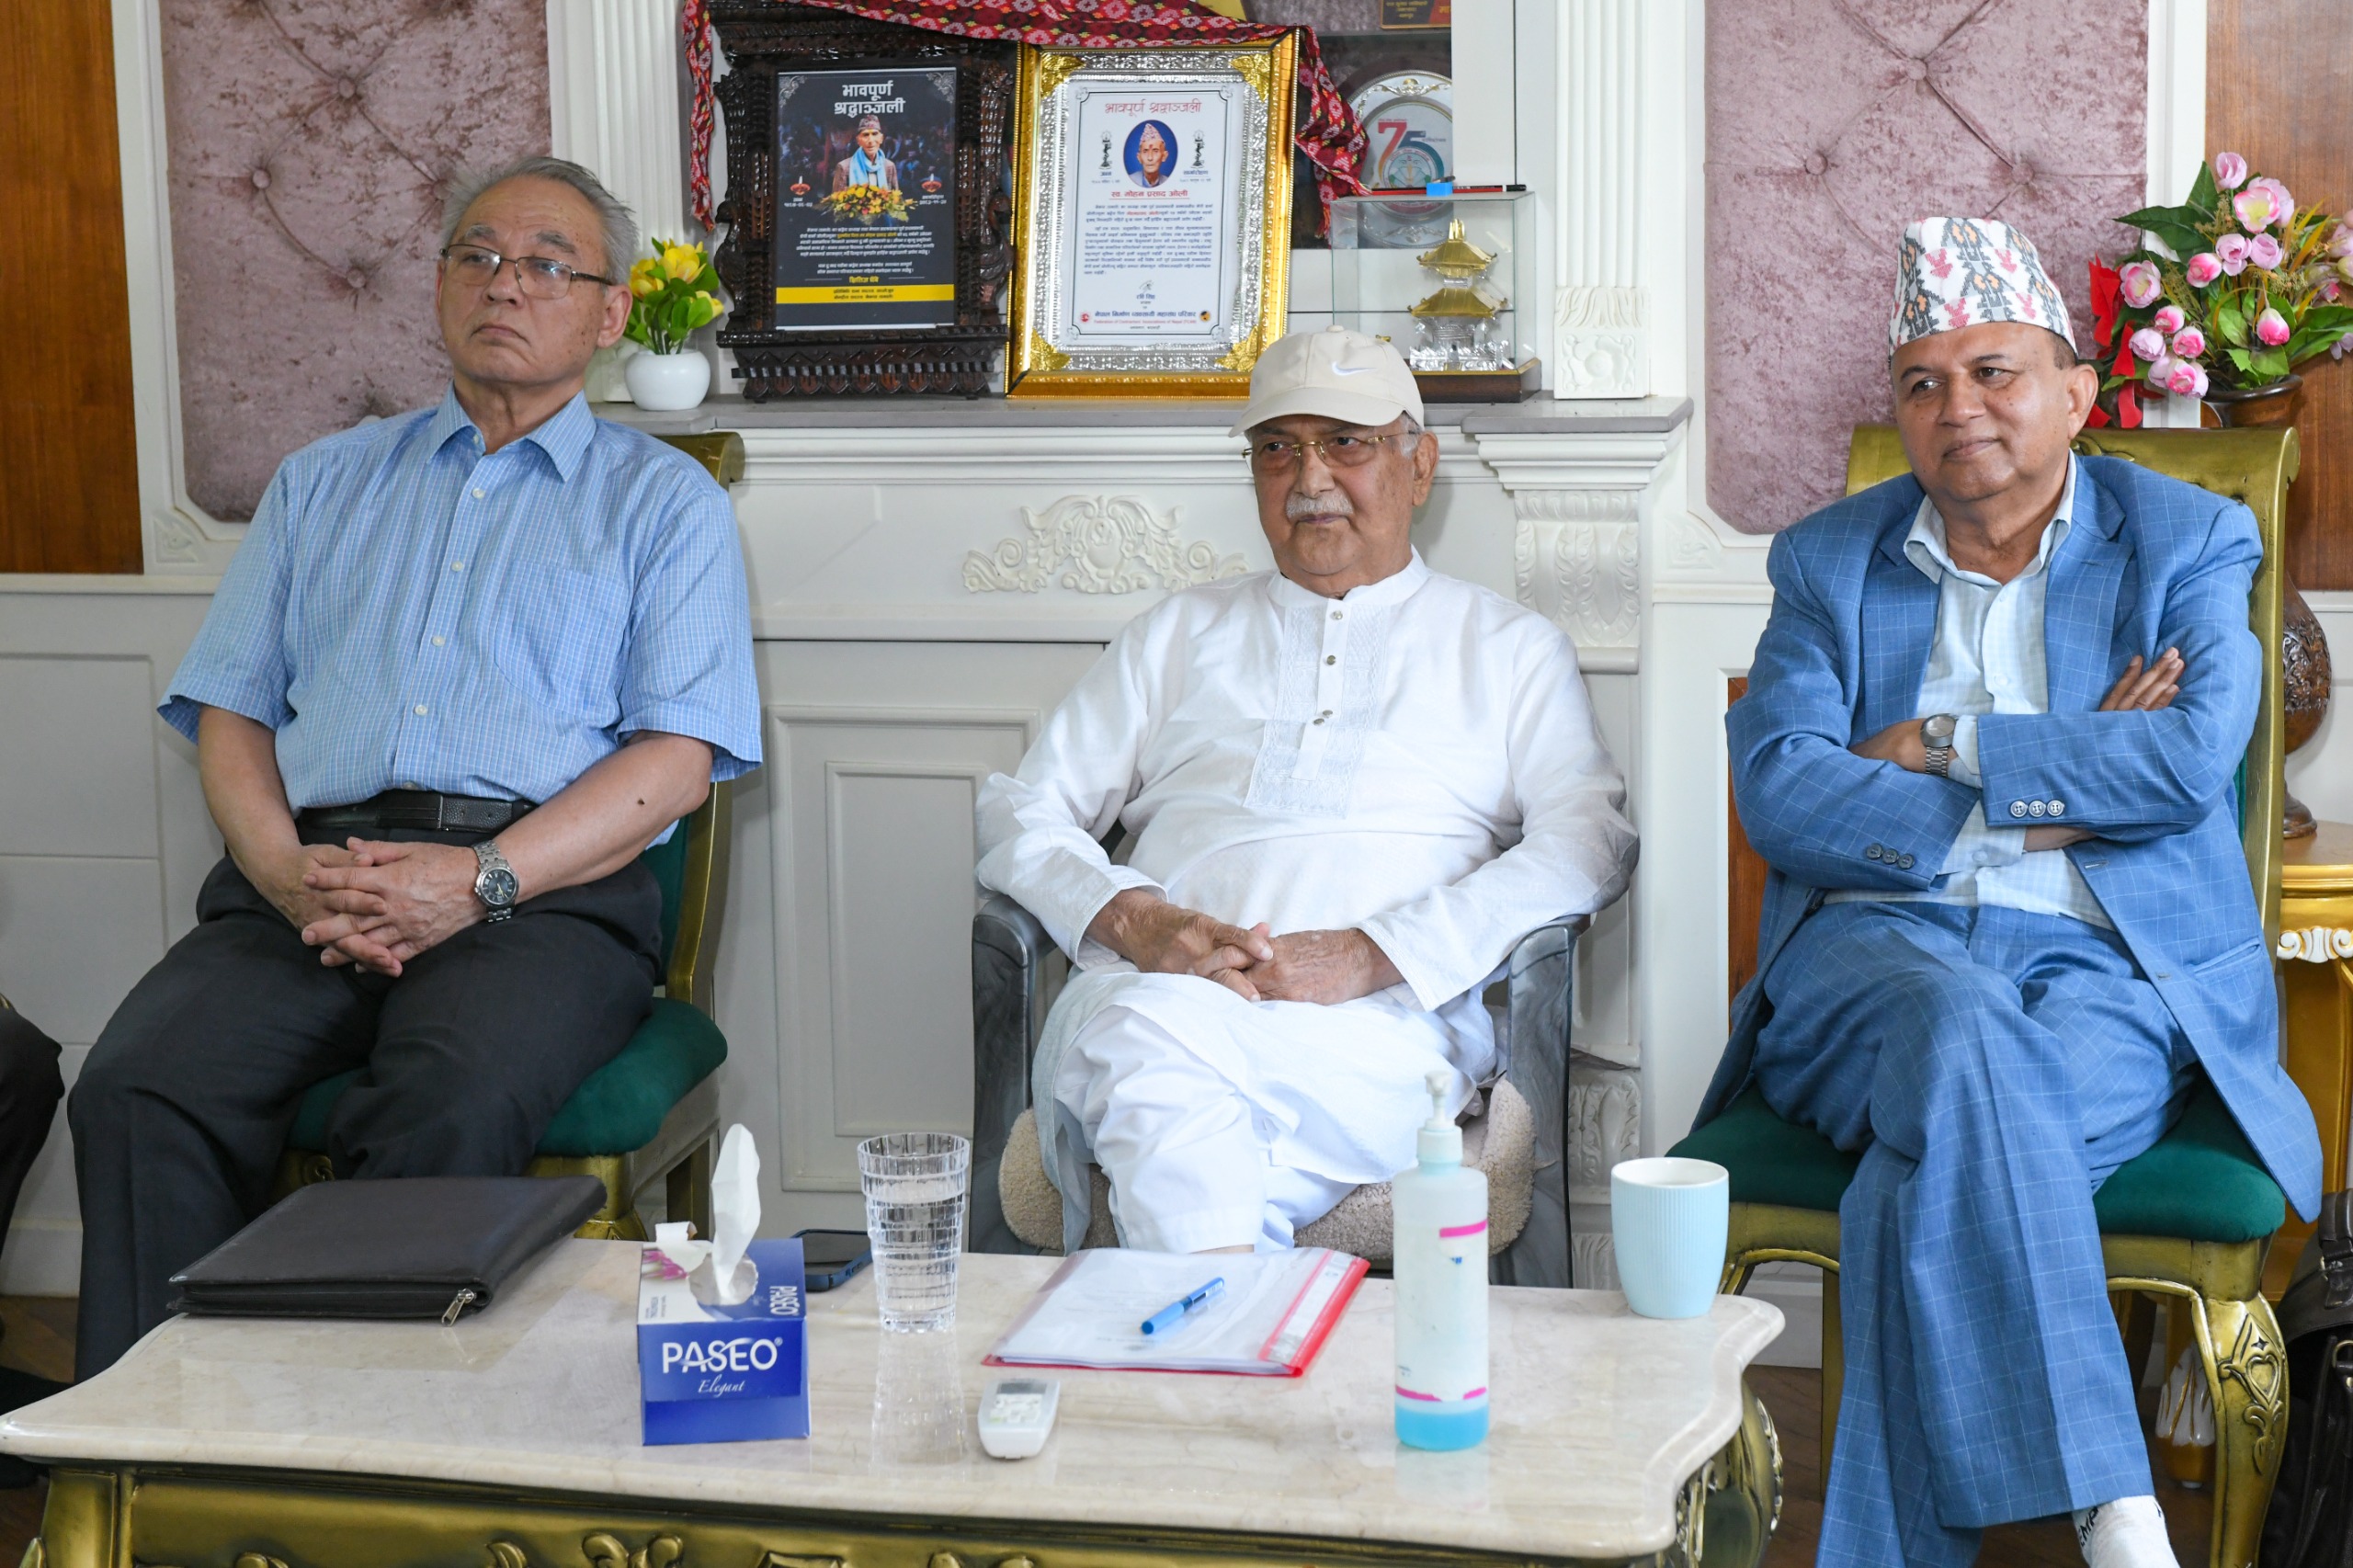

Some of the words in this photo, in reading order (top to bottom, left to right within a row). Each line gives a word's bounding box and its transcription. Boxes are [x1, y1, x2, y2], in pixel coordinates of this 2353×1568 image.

[842, 80, 894, 101] भावपूर्ण
[1105, 98, 1146, 117] भावपूर्ण
[1378, 121, 1445, 182] 75
[1124, 189, 1144, 198] मोहन
[769, 1285, 801, 1316] PASEO
[662, 1337, 779, 1374] PASEO
[697, 1374, 746, 1398] Elegant
